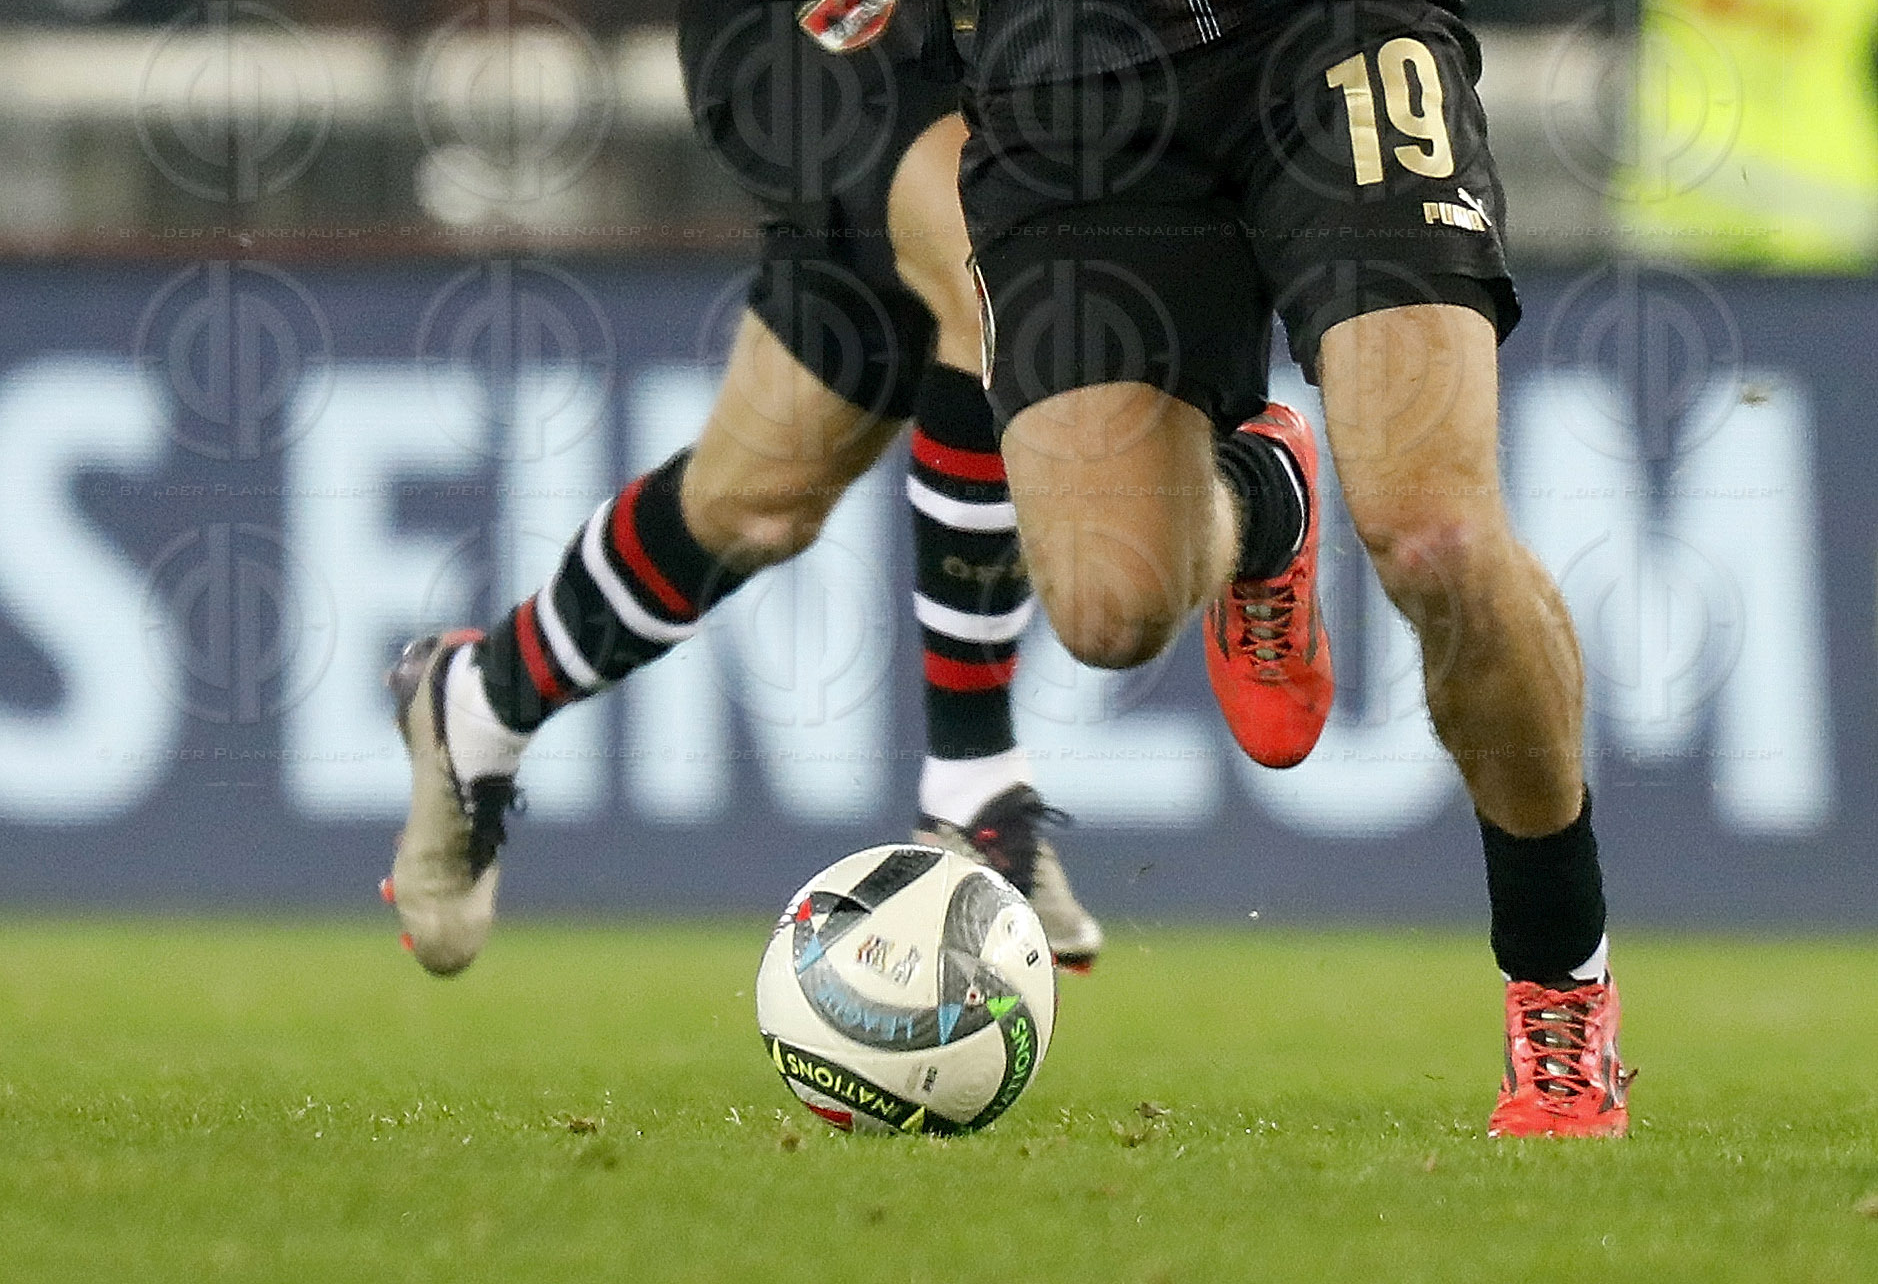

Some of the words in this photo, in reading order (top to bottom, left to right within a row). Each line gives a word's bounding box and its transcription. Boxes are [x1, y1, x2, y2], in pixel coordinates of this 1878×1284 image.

[1325, 37, 1455, 186] 19
[1422, 201, 1487, 233] PUMA
[786, 1052, 895, 1116] NATIONS
